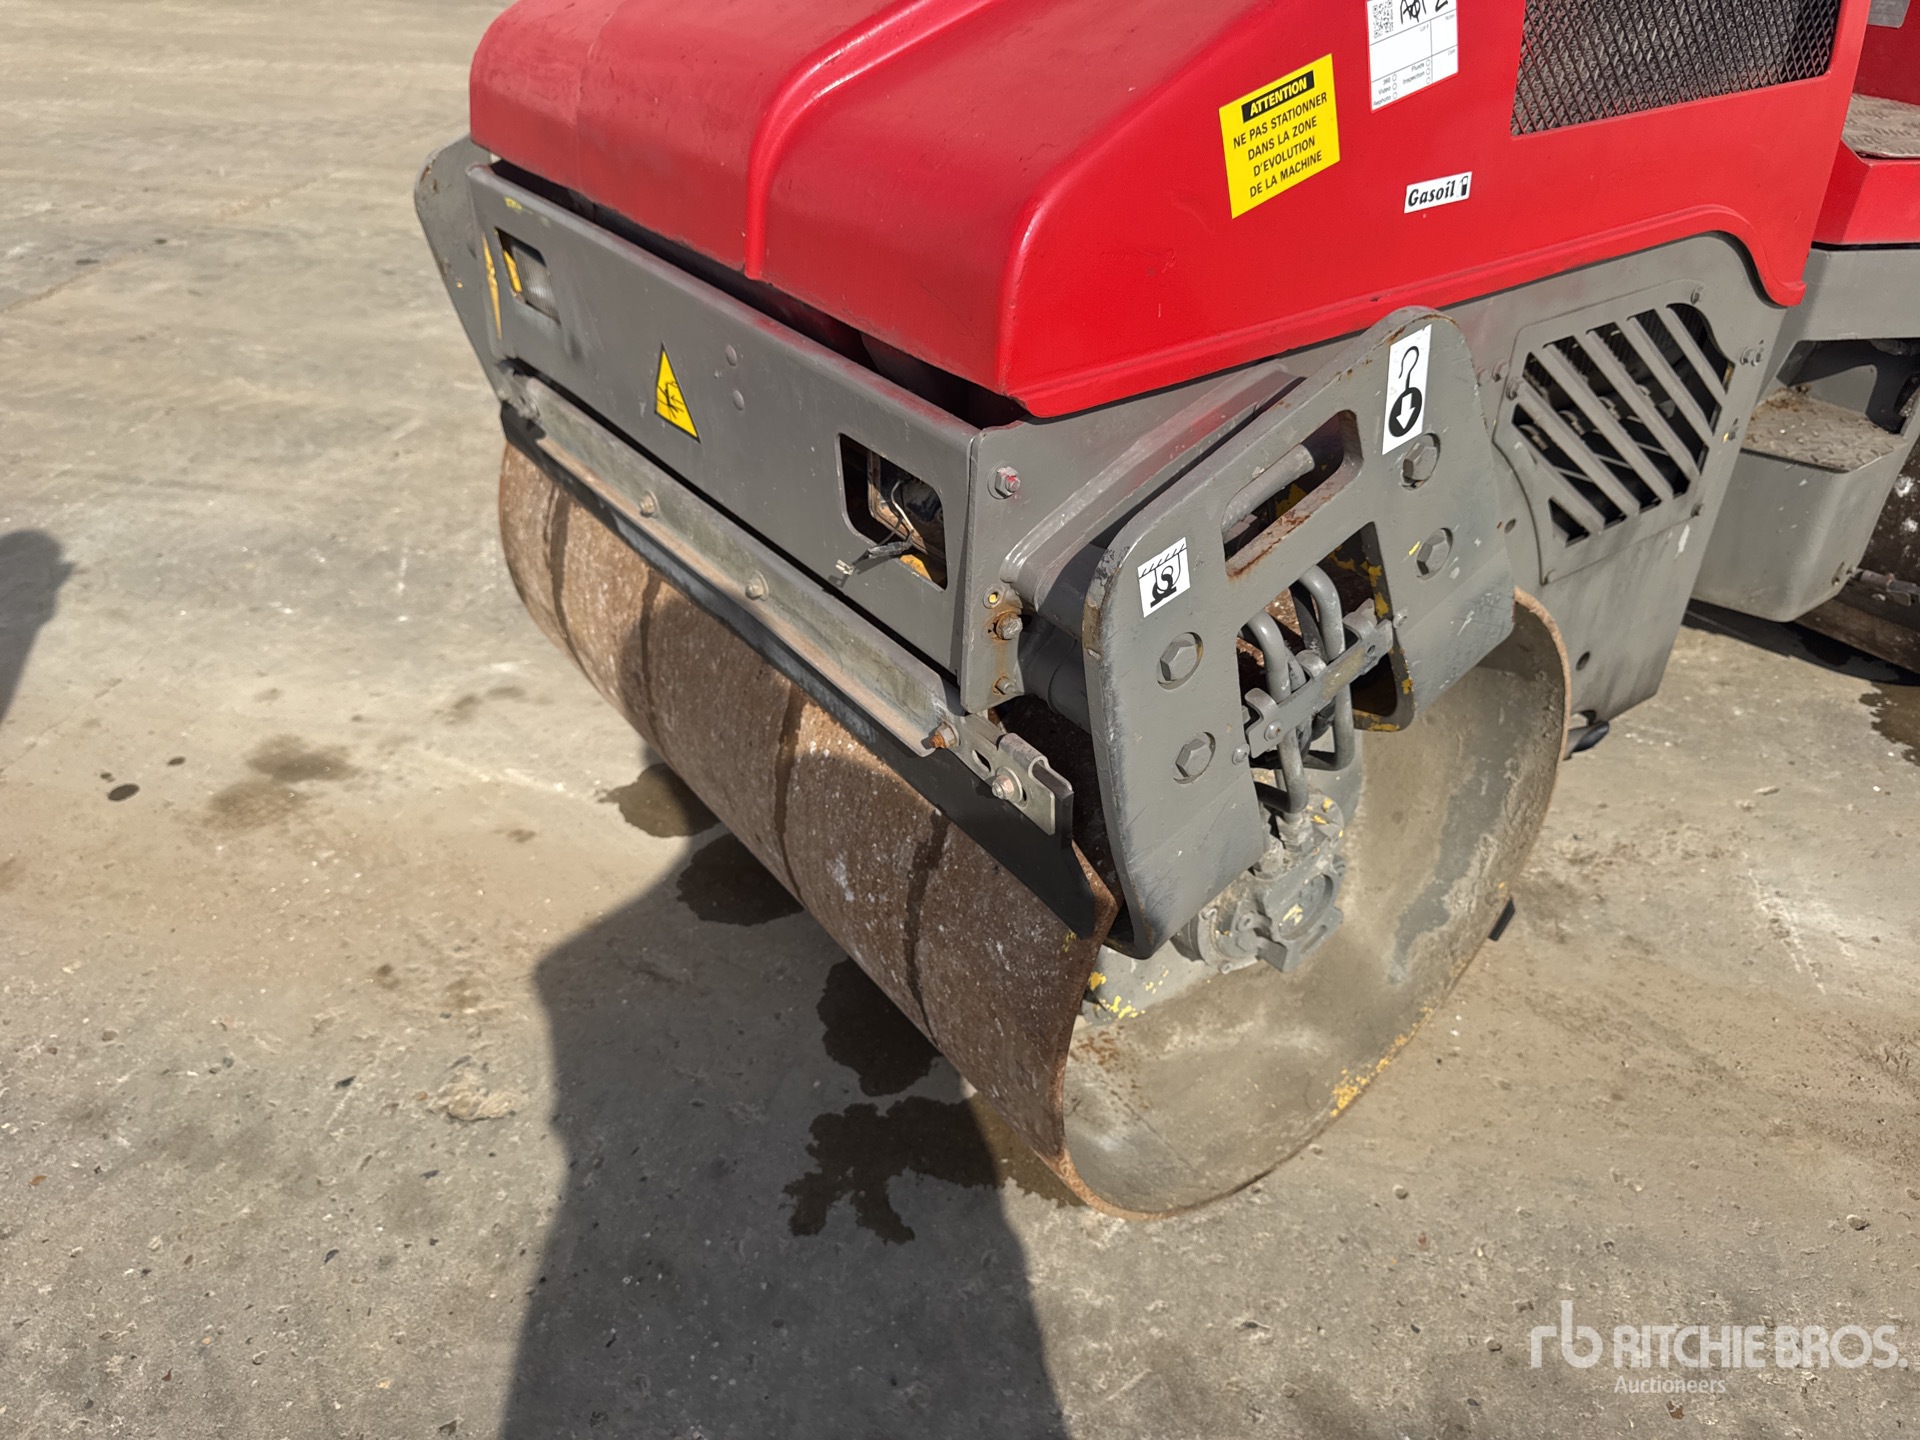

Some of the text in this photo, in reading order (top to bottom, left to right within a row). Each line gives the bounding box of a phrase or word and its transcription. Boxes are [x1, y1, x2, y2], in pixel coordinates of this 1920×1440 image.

[1250, 76, 1308, 117] ATTENTION
[1233, 92, 1327, 149] NE PAS STATIONNER
[1248, 116, 1318, 161] DANS LA ZONE
[1249, 151, 1322, 198] DE LA MACHINE
[1253, 136, 1316, 177] D'EVOLUTION
[1407, 179, 1456, 207] Gasoil
